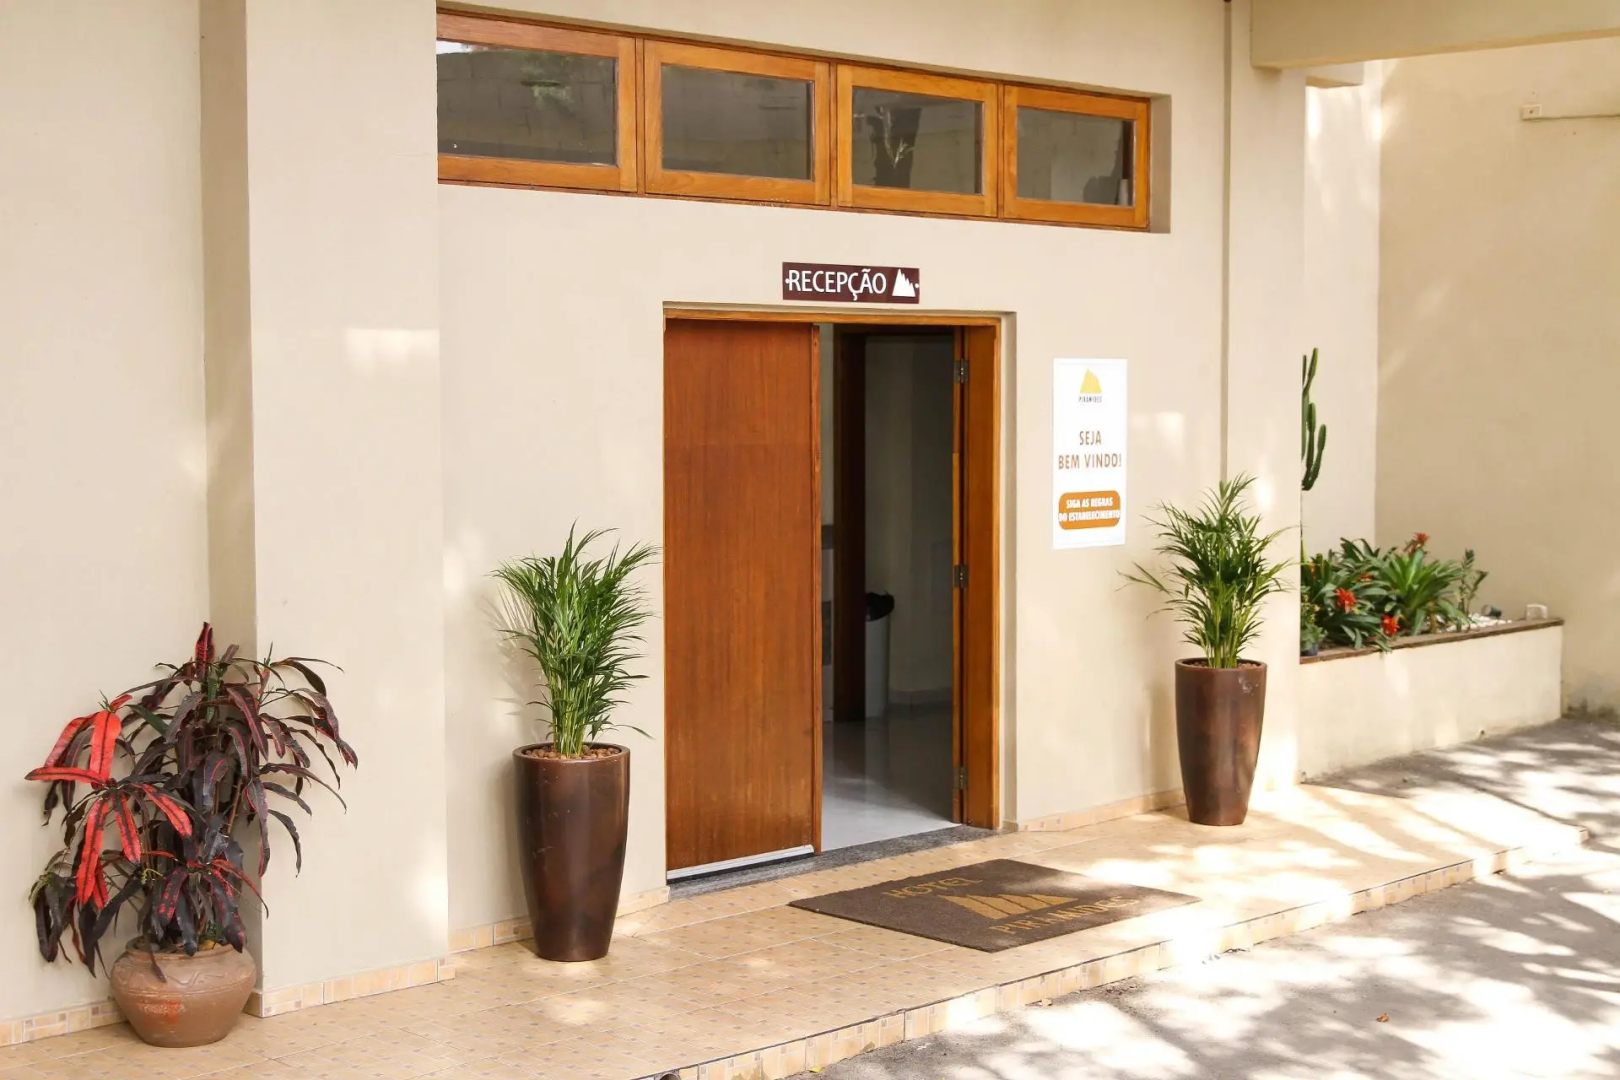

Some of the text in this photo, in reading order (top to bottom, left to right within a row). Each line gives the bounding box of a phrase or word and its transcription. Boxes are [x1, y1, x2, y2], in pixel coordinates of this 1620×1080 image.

[787, 268, 887, 301] RECEPÇÃO
[1079, 430, 1102, 446] SEJA
[1058, 452, 1122, 470] BEM VINDO!
[1066, 496, 1114, 509] SIGA AS REGRAS
[1058, 512, 1068, 522] DO
[881, 877, 983, 899] HOTEL
